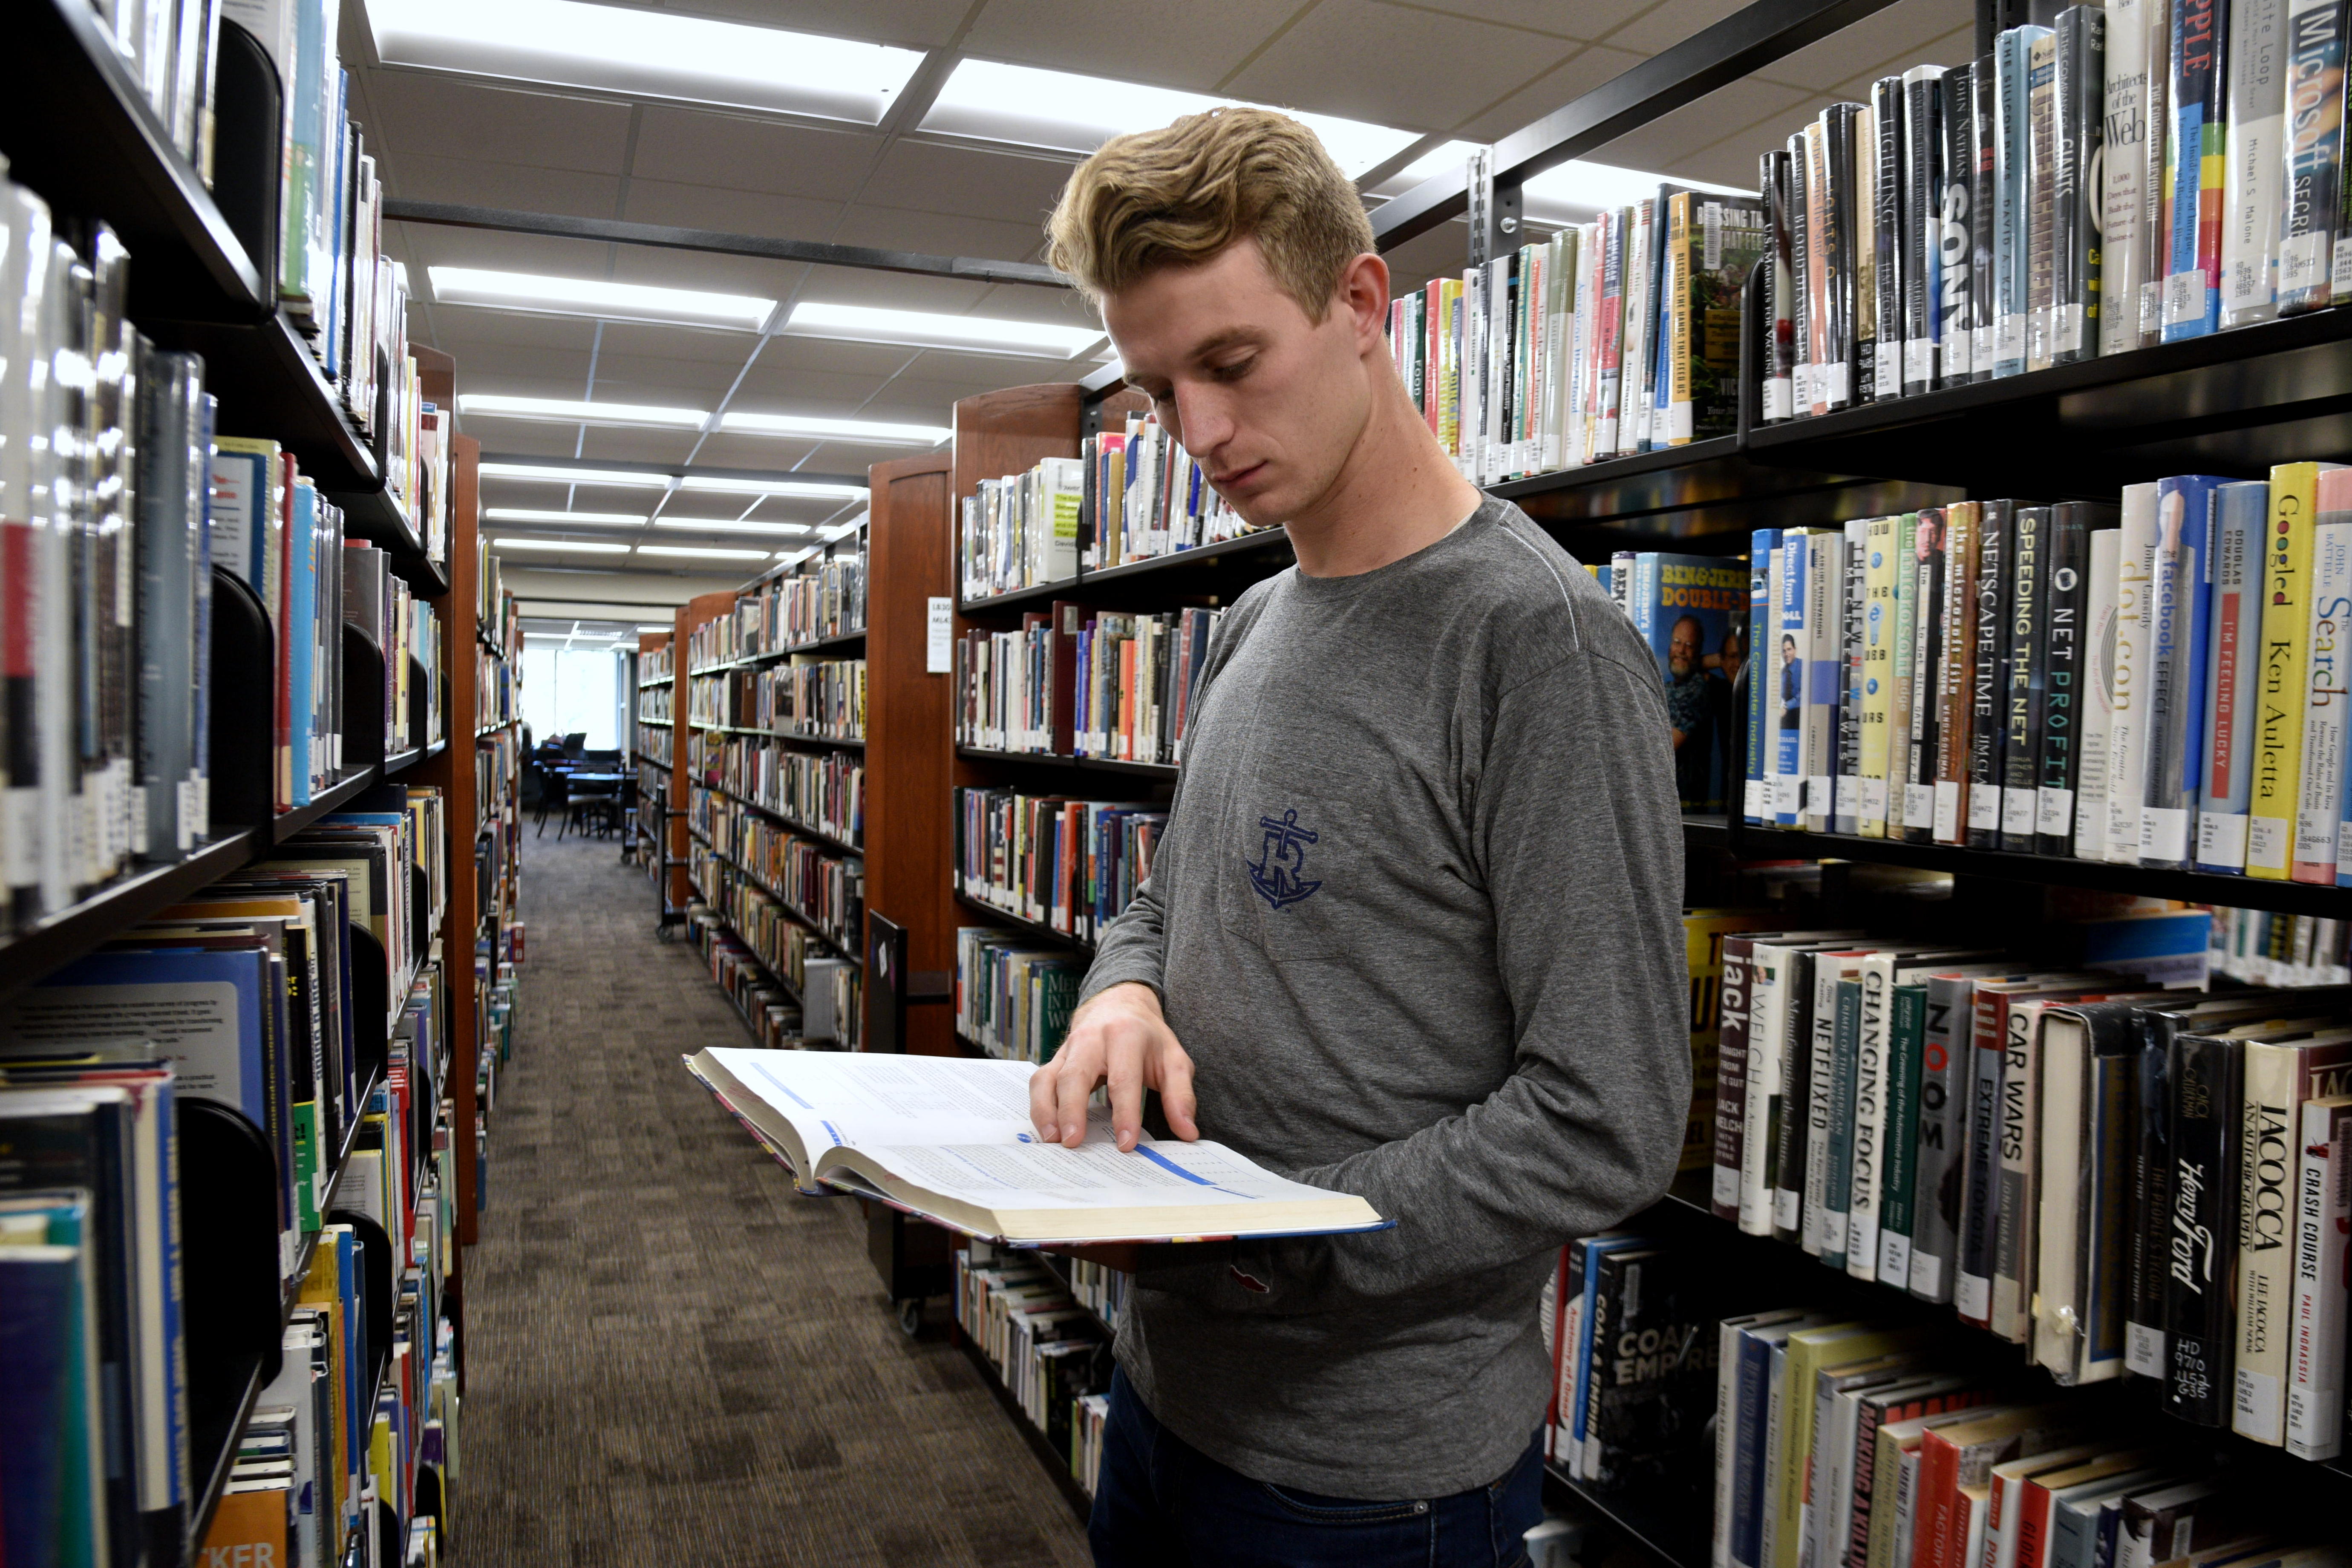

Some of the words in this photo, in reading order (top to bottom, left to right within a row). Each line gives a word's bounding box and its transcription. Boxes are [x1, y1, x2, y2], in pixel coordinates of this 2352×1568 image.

[2060, 40, 2069, 59] THE
[2257, 43, 2274, 86] Loop
[1954, 75, 1969, 112] JOHN
[2003, 75, 2012, 134] SILICON
[2060, 60, 2069, 113] COMPANY
[2121, 89, 2136, 105] the
[2293, 9, 2337, 173] Microsoft
[1914, 89, 1924, 138] INVENTING
[2104, 107, 2145, 150] Web
[2150, 106, 2161, 157] COMPUTER
[2189, 124, 2198, 142] The
[1956, 118, 1969, 178] NATHAN
[2003, 141, 2012, 181] BOYS
[2055, 139, 2074, 198] GIANTS
[2188, 145, 2197, 171] Inside
[2245, 138, 2257, 182] Michael
[1880, 119, 1895, 223] LIGHTING
[2147, 161, 2159, 222] REVOLUTION
[2186, 176, 2196, 199] Story
[2003, 199, 2011, 246] DAVID
[2106, 220, 2124, 230] Future
[2107, 204, 2123, 214] Built
[2125, 202, 2135, 211] the
[2174, 187, 2184, 225] Business
[2243, 206, 2255, 245] Malone
[1794, 214, 1806, 268] BLOOD
[2106, 233, 2133, 244] Business
[1676, 253, 1686, 291] BLESSING
[1764, 251, 1774, 303] MARKETS
[1676, 294, 1685, 308] THE
[1764, 306, 1773, 326] FOR
[1675, 311, 1685, 338] HANDS
[1676, 340, 1686, 360] THAT
[1413, 360, 1422, 396] FOOD
[1676, 362, 1686, 382] FEED
[1676, 384, 1685, 394] US
[1786, 542, 1798, 575] Direct
[1905, 526, 1917, 548] the
[1955, 526, 1968, 553] the
[2143, 544, 2156, 570] John
[2221, 530, 2233, 585] EDWARDS
[2233, 529, 2244, 585] DOUGLAS
[2269, 494, 2300, 605] Googled
[1853, 544, 1865, 585] THE
[1920, 565, 1929, 585] The
[2015, 517, 2036, 636] SPEEDING
[2322, 533, 2335, 588] BATTELLE
[2335, 543, 2346, 576] JOHN
[1784, 578, 1796, 605] from
[1816, 585, 1826, 640] RESERVATIONS
[1896, 550, 1916, 676] microsoft
[1950, 563, 1966, 652] microsoft
[1977, 531, 2000, 653] NETSCAPE
[2139, 584, 2153, 630] Cassidy
[2157, 561, 2179, 656] facebook
[1752, 622, 1762, 647] The
[1842, 567, 1853, 672] MICHAEL
[1850, 601, 1864, 644] NEW
[2052, 608, 2075, 660] NET
[2114, 561, 2151, 711] dot.con
[2221, 622, 2234, 641] I'M
[2340, 620, 2350, 632] The
[1916, 645, 1925, 666] Get
[2011, 642, 2031, 689] THE
[2266, 640, 2292, 694] Ken
[2310, 596, 2351, 709] Search
[1748, 651, 1761, 716] Computer
[1898, 679, 1910, 712] edge
[1915, 672, 1924, 696] BILL
[1948, 663, 1962, 695] file
[1974, 657, 1995, 717] TIME
[2154, 661, 2171, 717] EFFECT
[2217, 650, 2233, 713] FEELING
[1839, 689, 1850, 761] LEWIS
[1912, 706, 1923, 738] GATES
[1941, 704, 1951, 733] WENDY
[2010, 698, 2028, 746] NET
[2044, 671, 2072, 788] PROFIT
[2318, 721, 2328, 750] Rewrote
[2329, 726, 2339, 742] How
[1748, 721, 1759, 775] Industry
[1939, 738, 1950, 779] GOLDMAN
[1977, 732, 1991, 756] JIM
[2119, 744, 2130, 780] Greatest
[2215, 721, 2228, 768] LUCKY
[2259, 705, 2287, 799] Auletta
[2307, 734, 2317, 773] Transformed
[2326, 744, 2338, 767] Google
[2316, 765, 2326, 781] Rules
[2326, 771, 2336, 784] and
[1722, 950, 1753, 1032] jack
[1817, 978, 1827, 1008] Keating
[1839, 997, 1850, 1035] CRIMES
[1904, 997, 1914, 1029] palgrave
[1747, 994, 1767, 1084] WELCH
[1782, 998, 1800, 1098] Manufacturing
[1839, 1038, 1848, 1052] OF
[1859, 971, 1882, 1116] CHANGING
[1900, 1036, 1911, 1050] The
[2005, 1014, 2029, 1068] CAR
[1811, 1018, 1831, 1130] NETFLIXED
[1838, 1055, 1848, 1077] THE
[1895, 1052, 1908, 1087] Greening
[1834, 1080, 1848, 1135] AMERICAN
[1974, 1078, 1994, 1172] EXTREME
[2002, 1081, 2026, 1161] WARS
[2246, 1101, 2256, 1123] AN
[1745, 1113, 1755, 1165] American
[1893, 1113, 1905, 1158] Automotive
[1851, 1124, 1874, 1211] FOCUS
[1891, 1159, 1902, 1193] Industry
[2239, 1126, 2255, 1251] AUTOBIOGRAPHY
[2254, 1105, 2288, 1251] IACOCCA
[1998, 1179, 2012, 1220] JONATHAN
[2173, 1158, 2205, 1228] Henry
[2303, 1168, 2321, 1216] CRASH
[2170, 1219, 2214, 1295] Ford
[2300, 1222, 2318, 1281] COURSE
[2247, 1270, 2256, 1291] WITH
[2257, 1275, 2269, 1296] LEE
[1593, 1294, 1608, 1348] COAL
[2245, 1294, 2255, 1326] WILLIAM
[2254, 1298, 2269, 1354] IACOCCA
[2300, 1294, 2312, 1320] PAUL
[2174, 1352, 2205, 1372] 9710
[2177, 1339, 2200, 1355] HD
[2244, 1328, 2254, 1354] NOVAK
[2297, 1325, 2310, 1383] INGRASSIA
[2177, 1383, 2208, 1399] G35
[1853, 1404, 1876, 1492] MAKING
[1896, 1462, 1911, 1505] MAKING
[1931, 1504, 1949, 1567] FACTORY
